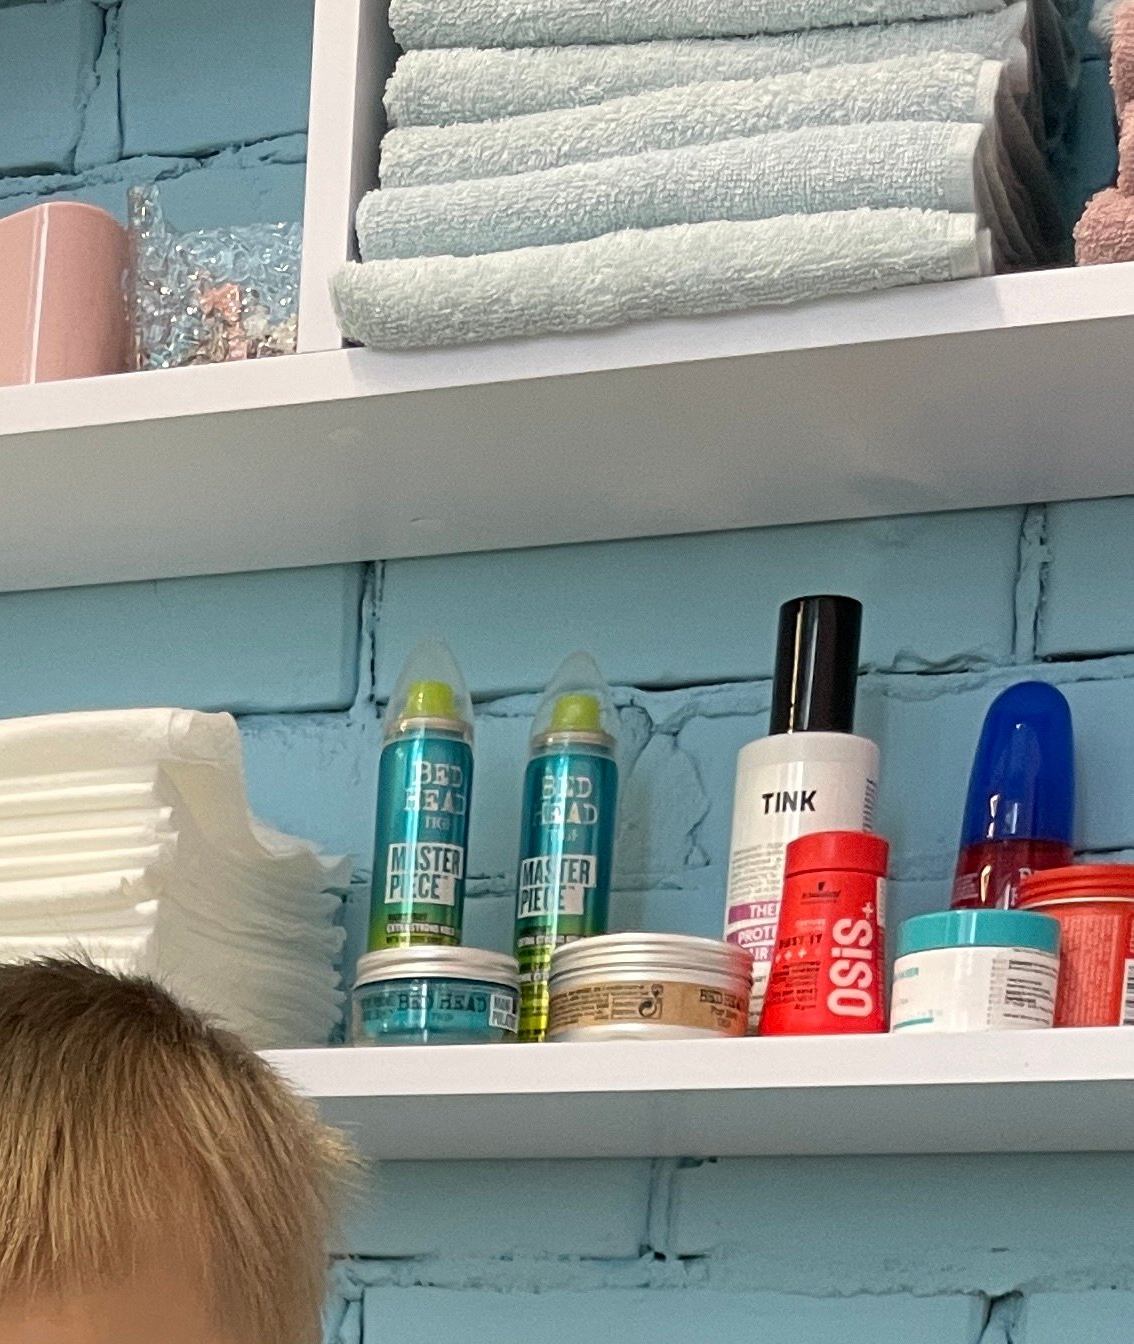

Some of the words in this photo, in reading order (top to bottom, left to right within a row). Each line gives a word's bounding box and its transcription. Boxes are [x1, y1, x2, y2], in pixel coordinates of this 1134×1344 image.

[412, 760, 464, 788] BED
[541, 775, 593, 800] BED
[404, 787, 466, 817] HEAD
[762, 790, 817, 815] TINK
[391, 845, 461, 877] MASTER
[522, 858, 591, 889] MASTER
[389, 872, 442, 900] PIECE
[520, 884, 566, 915] PIECE
[440, 993, 488, 1013] HEAD
